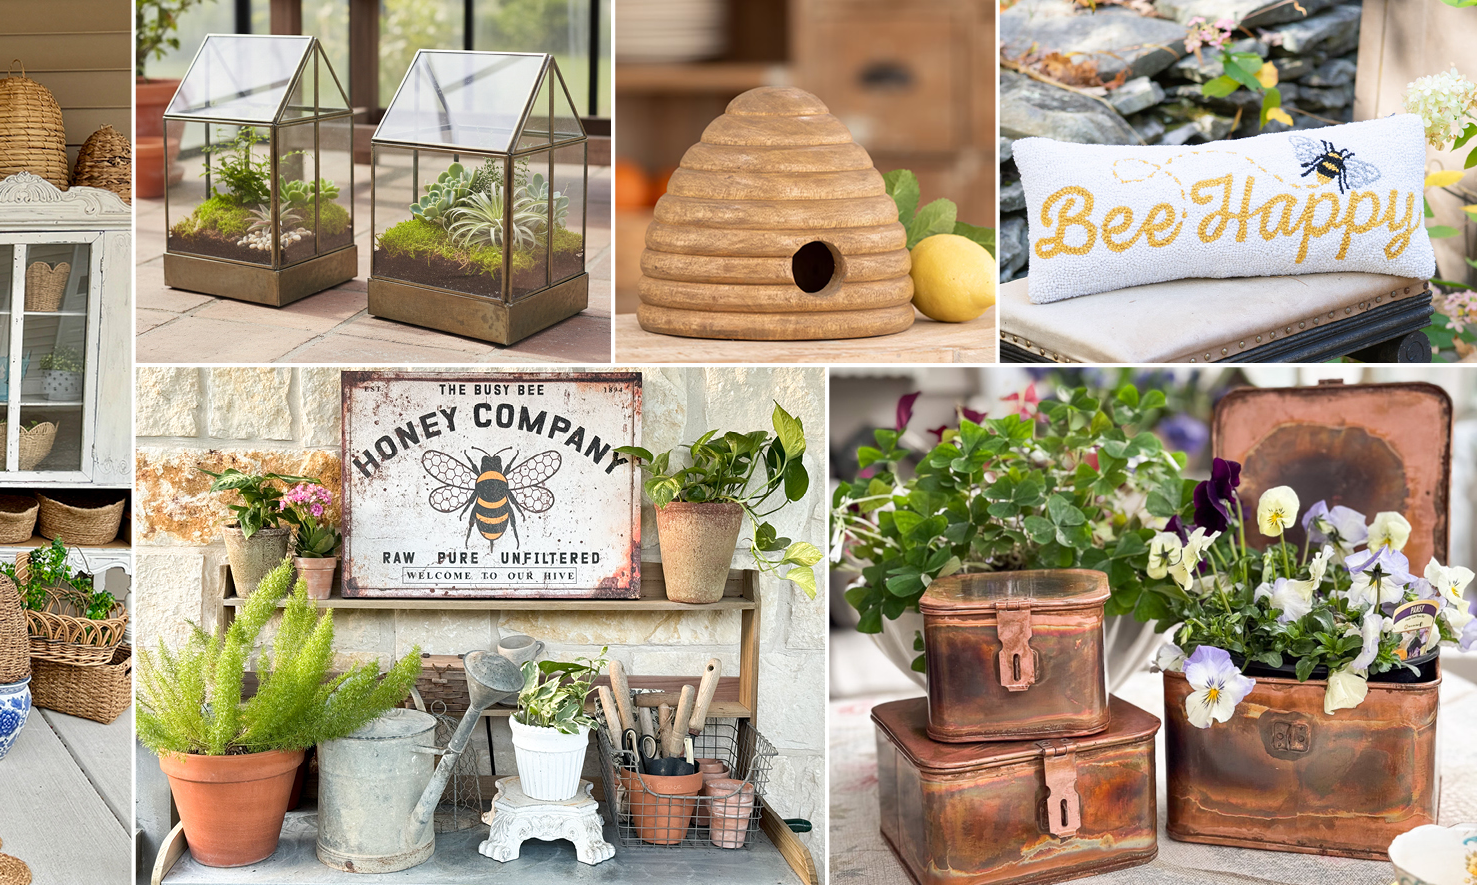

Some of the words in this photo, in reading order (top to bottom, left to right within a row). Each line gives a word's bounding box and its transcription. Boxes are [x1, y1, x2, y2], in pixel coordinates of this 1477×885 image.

[1035, 186, 1184, 259] Bee
[1190, 174, 1423, 264] Happy
[439, 384, 466, 395] THE
[474, 384, 510, 396] BUSY
[518, 384, 545, 396] BEE
[352, 406, 458, 479] HONEY
[473, 402, 629, 475] COMPANY
[383, 552, 415, 564] RAW
[438, 552, 478, 564] PURE
[501, 552, 600, 564] UNFILTERED
[407, 571, 473, 580] WELCOME
[481, 571, 498, 580] TO
[507, 571, 534, 580] OUR
[543, 571, 575, 580] HIVE
